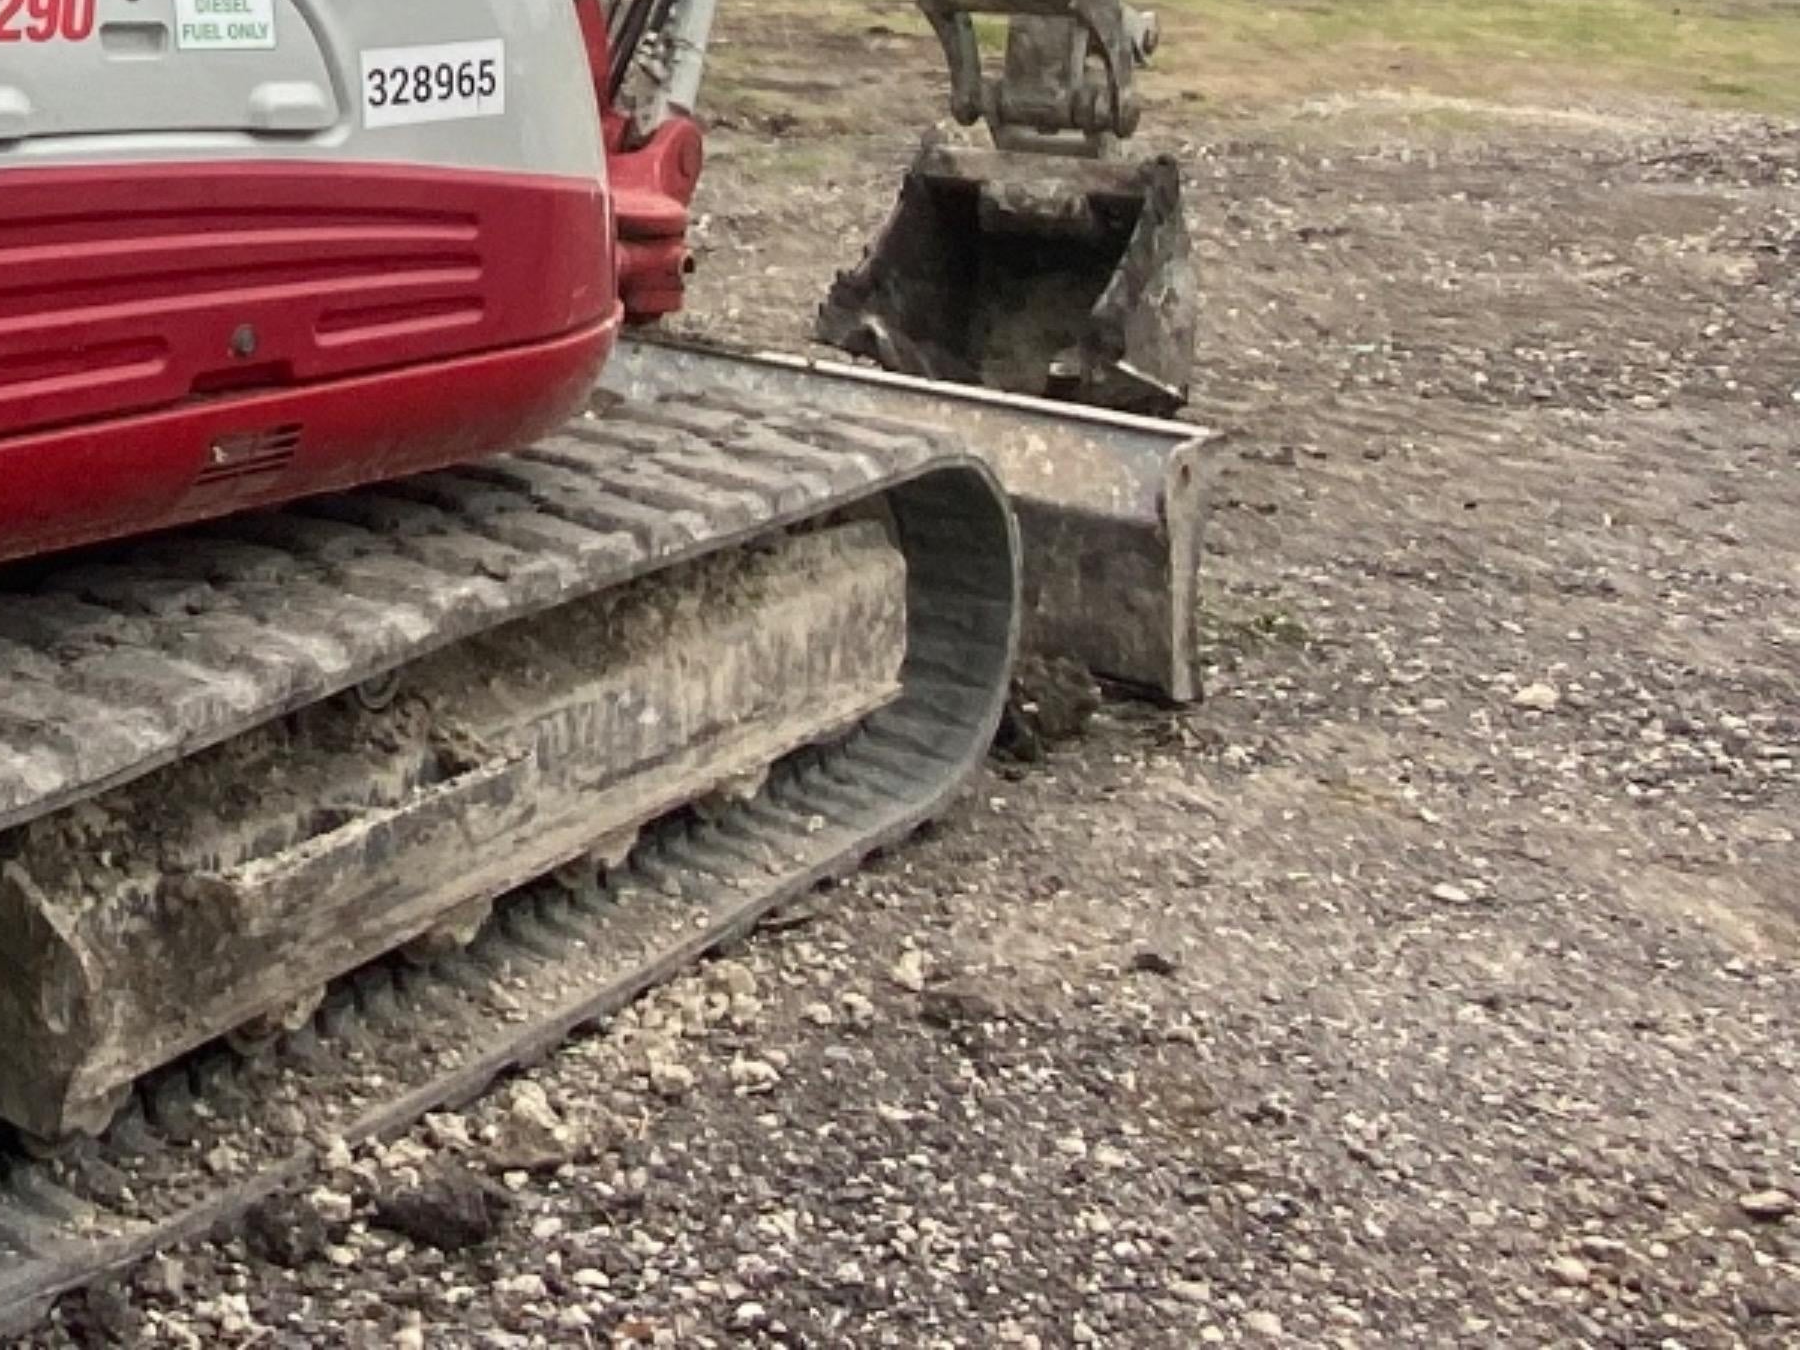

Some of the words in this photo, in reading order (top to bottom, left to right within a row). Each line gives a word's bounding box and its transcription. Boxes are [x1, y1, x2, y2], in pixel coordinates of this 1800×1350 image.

[182, 23, 224, 42] FUEL
[227, 22, 269, 41] ONLY
[368, 59, 496, 107] 328965
